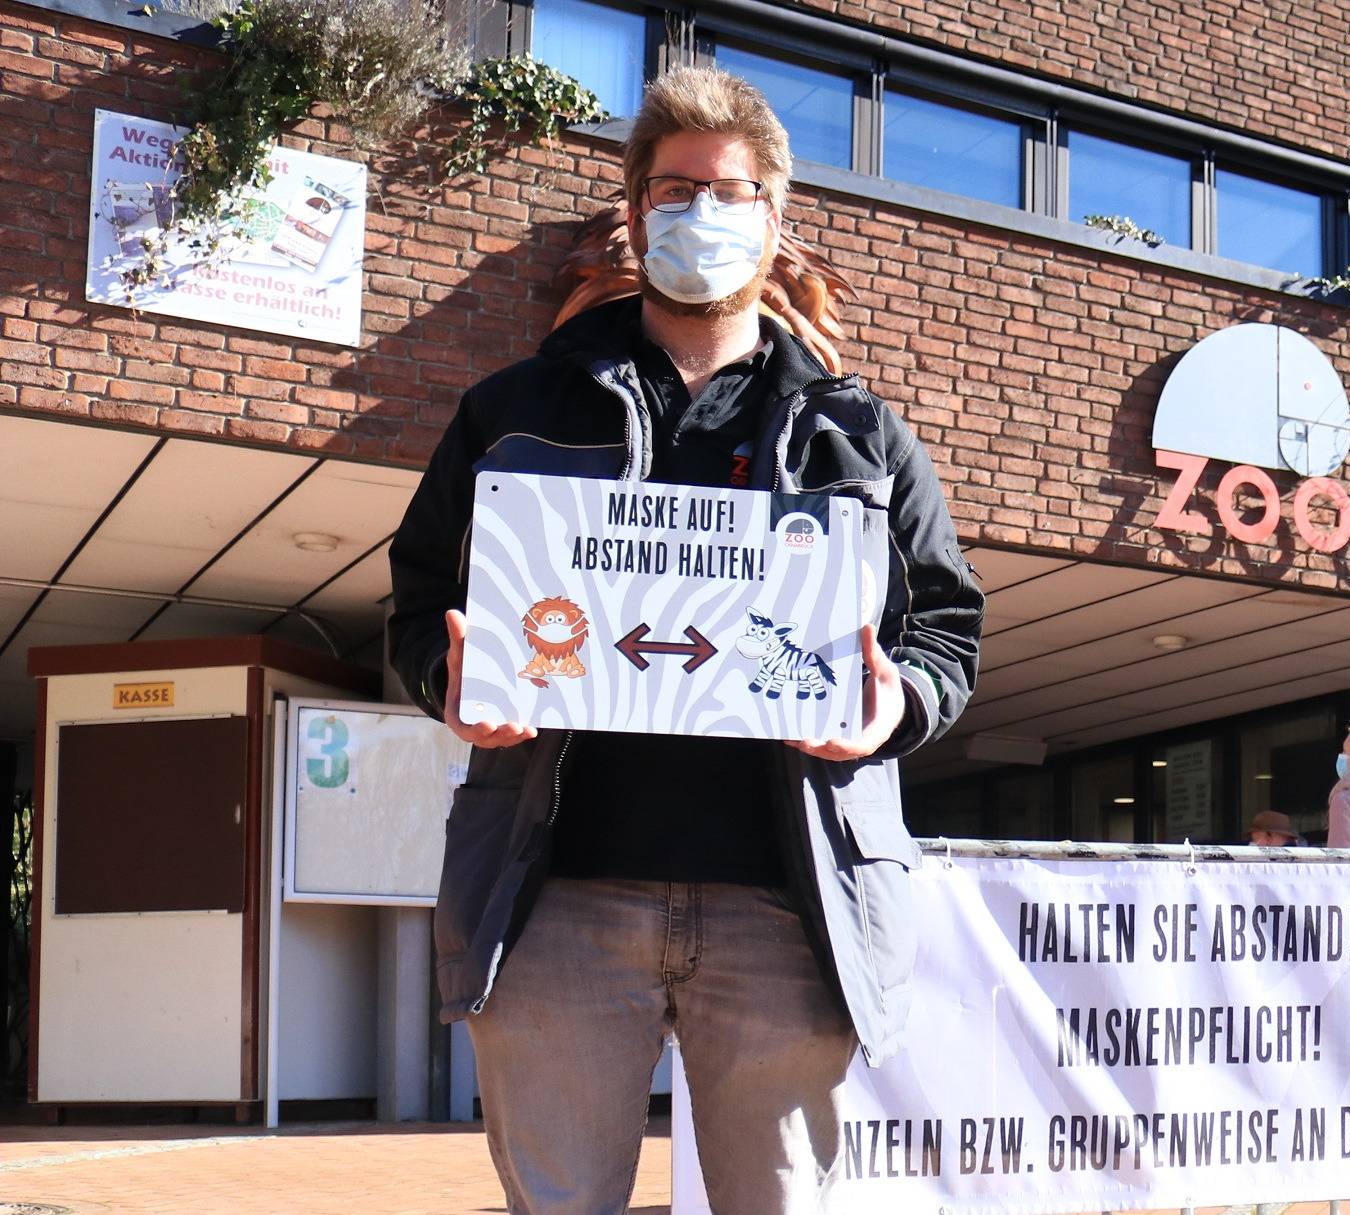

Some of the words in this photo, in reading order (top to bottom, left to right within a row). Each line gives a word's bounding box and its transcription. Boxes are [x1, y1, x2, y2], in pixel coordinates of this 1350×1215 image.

[109, 145, 188, 173] Aktion
[122, 126, 174, 154] Weg
[175, 280, 227, 300] asse
[233, 291, 341, 320] erhältlich!
[302, 287, 328, 300] an
[607, 493, 679, 530] MASKE
[687, 498, 735, 534] AUF!
[572, 536, 668, 575] ABSTAND
[678, 543, 765, 581] HALTEN!
[785, 533, 815, 544] ZOO
[118, 687, 170, 704] KASSE
[306, 716, 350, 788] 3
[1018, 902, 1136, 964] HALTEN
[1152, 902, 1197, 962] SIE
[1056, 1005, 1322, 1068] MASKENPFLICHT!
[844, 1119, 942, 1180] NZELN
[960, 1116, 1034, 1175] BZW.
[1048, 1109, 1279, 1172] GRUPPENWEISE
[1291, 1109, 1327, 1162] AN
